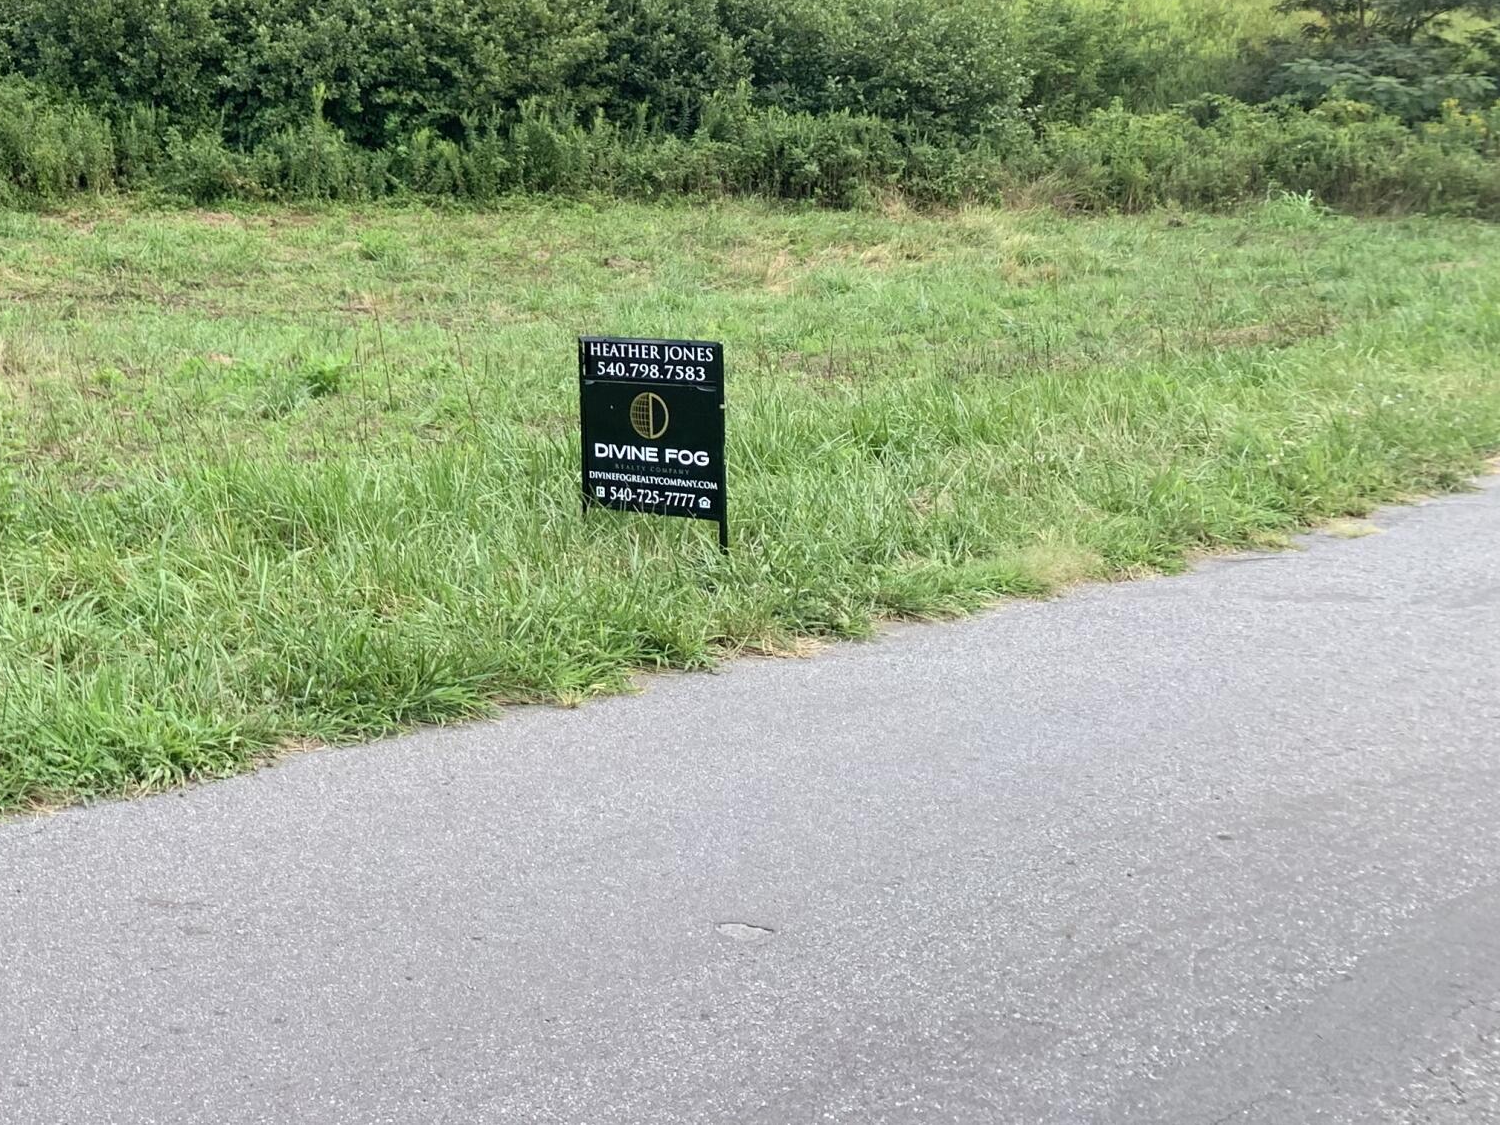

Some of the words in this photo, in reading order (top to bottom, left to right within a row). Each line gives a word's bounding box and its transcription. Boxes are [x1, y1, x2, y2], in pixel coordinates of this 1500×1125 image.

[590, 342, 660, 359] HEATHER
[664, 346, 714, 362] JONES
[597, 362, 706, 381] 540.798.7583
[594, 443, 659, 462] DIVINE
[665, 449, 710, 466] FOG
[589, 470, 718, 490] DIVINEFOGREALTYCOMPANY.COM
[610, 486, 695, 508] 540-725-7777
